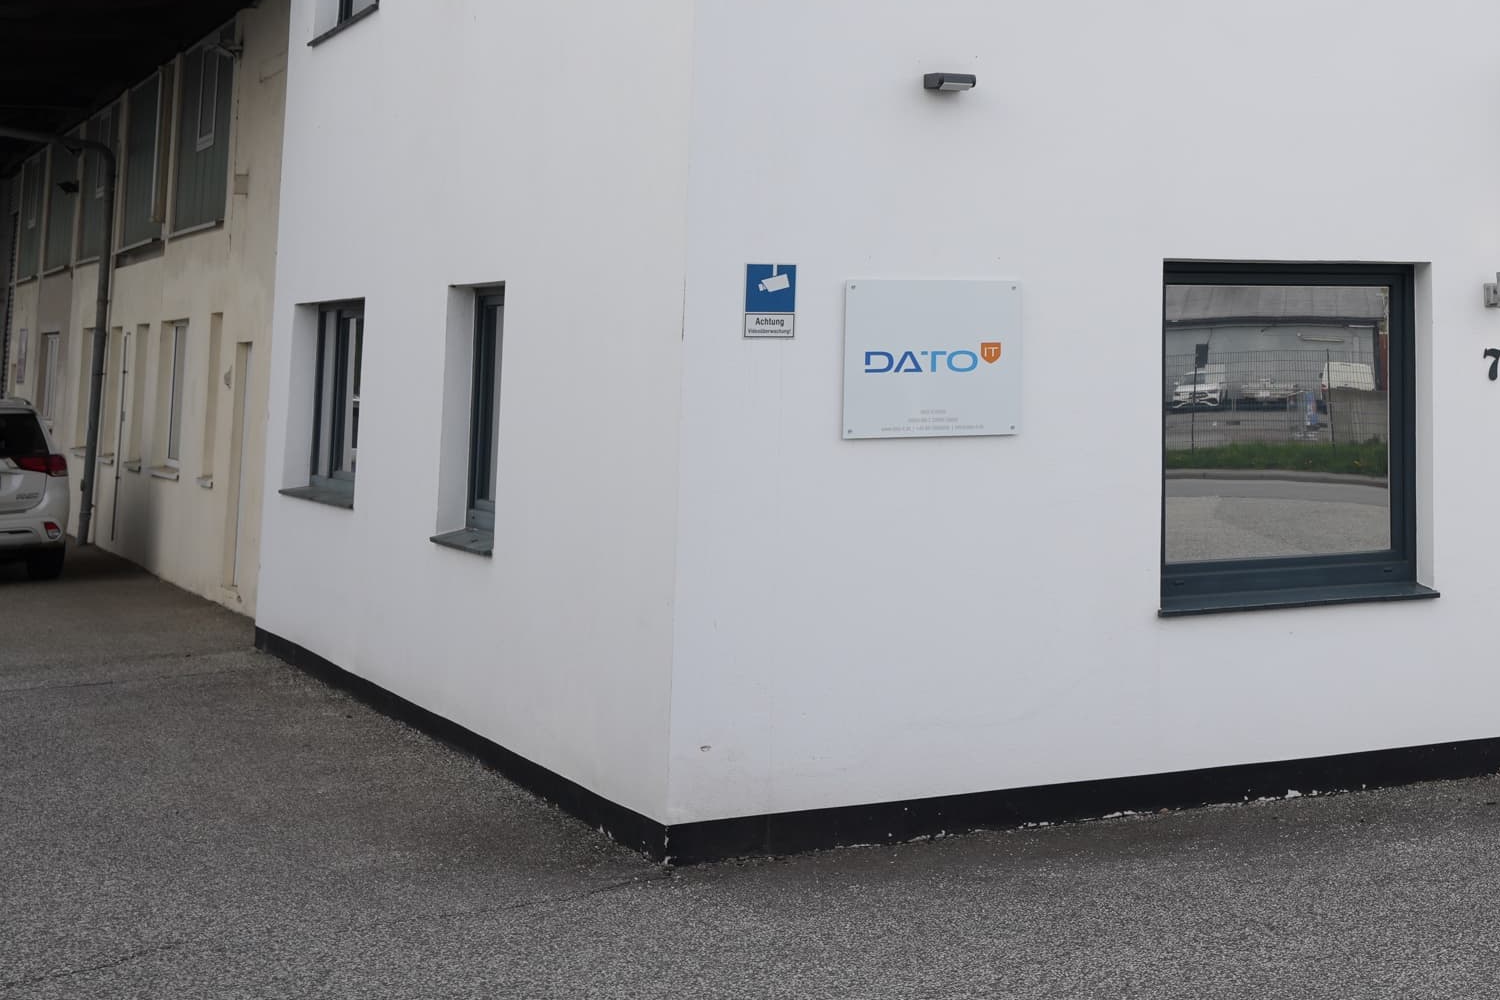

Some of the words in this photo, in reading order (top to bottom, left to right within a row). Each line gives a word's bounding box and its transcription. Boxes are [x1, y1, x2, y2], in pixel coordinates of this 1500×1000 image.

[755, 317, 785, 327] Achtung
[864, 350, 979, 373] DATO
[984, 346, 1000, 358] IT
